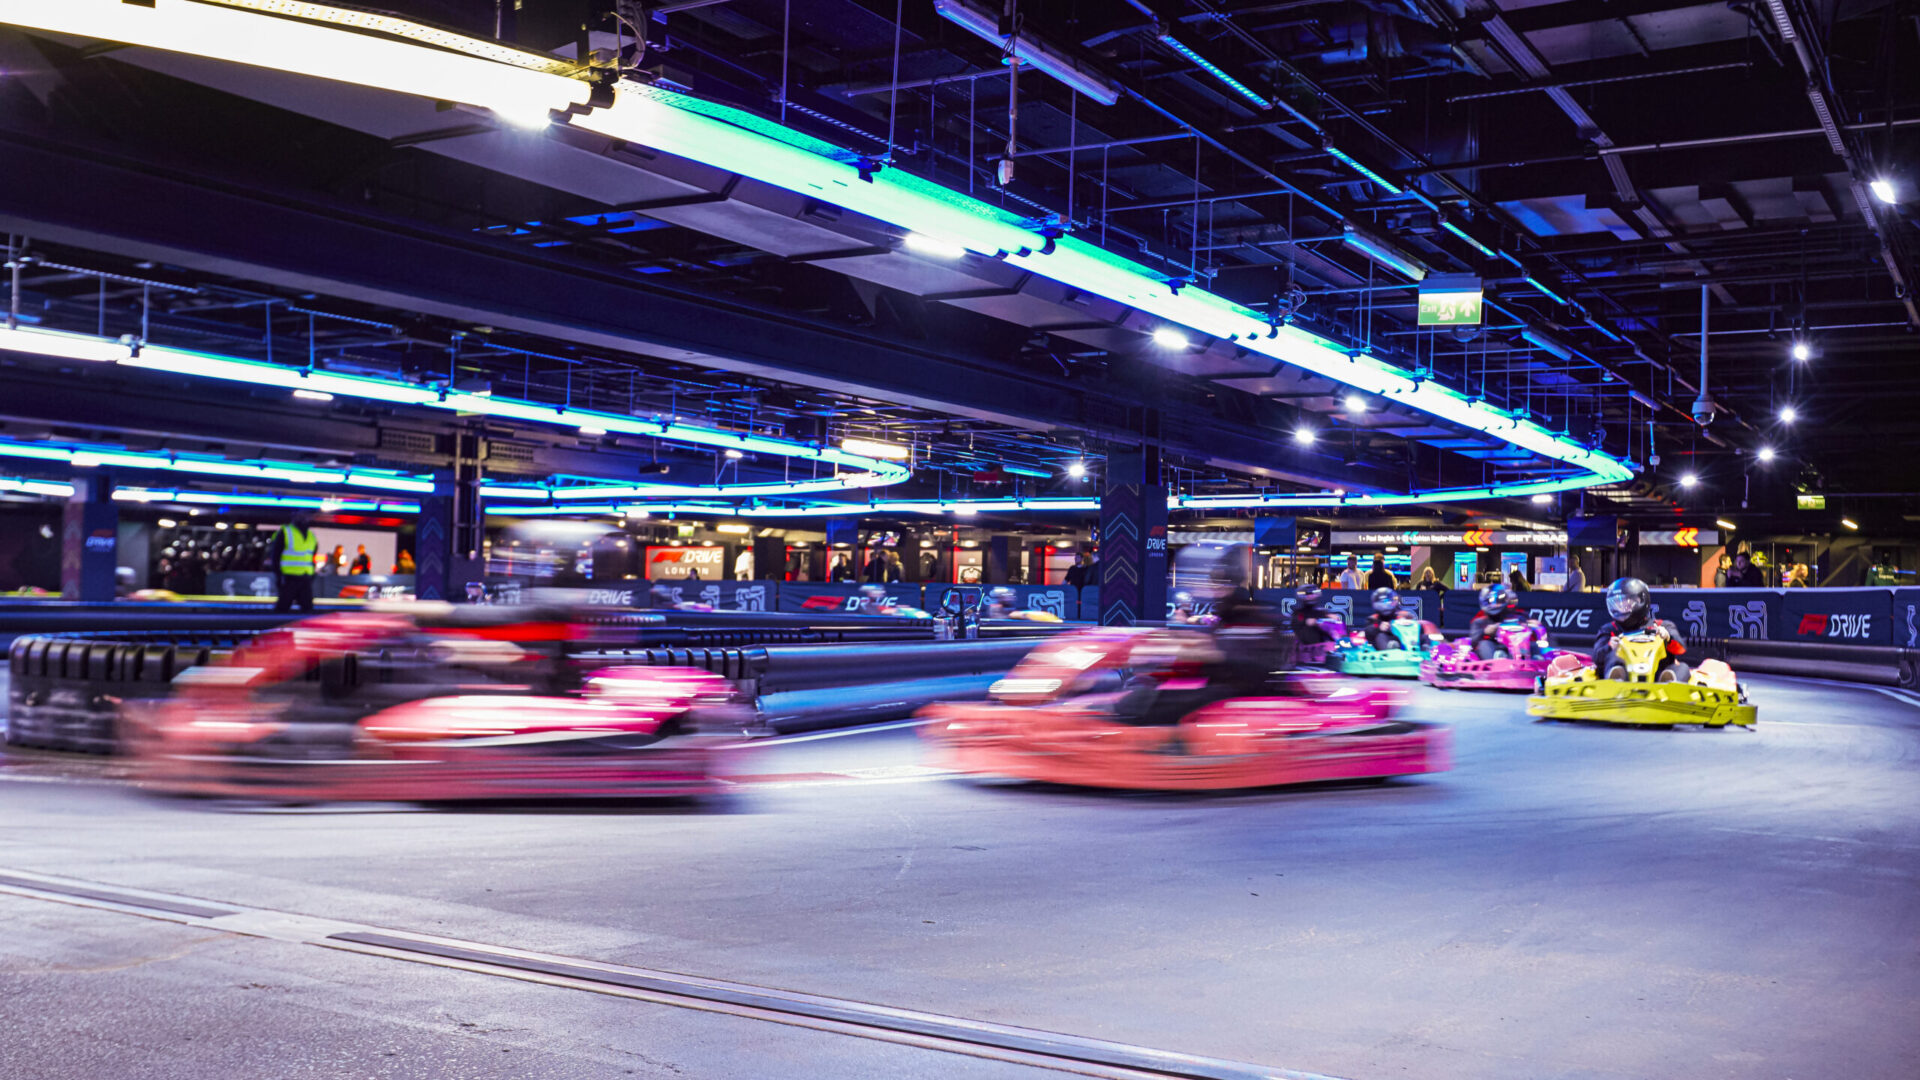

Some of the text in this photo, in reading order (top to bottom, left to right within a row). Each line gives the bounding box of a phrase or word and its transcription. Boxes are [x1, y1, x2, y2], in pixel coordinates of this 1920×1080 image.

[1146, 538, 1166, 550] DRIVE
[684, 550, 722, 564] DRIVE
[588, 590, 632, 605] DRIVE
[845, 596, 898, 611] DRVE
[1529, 608, 1593, 628] DRIVE
[1828, 614, 1871, 638] DRIVE
